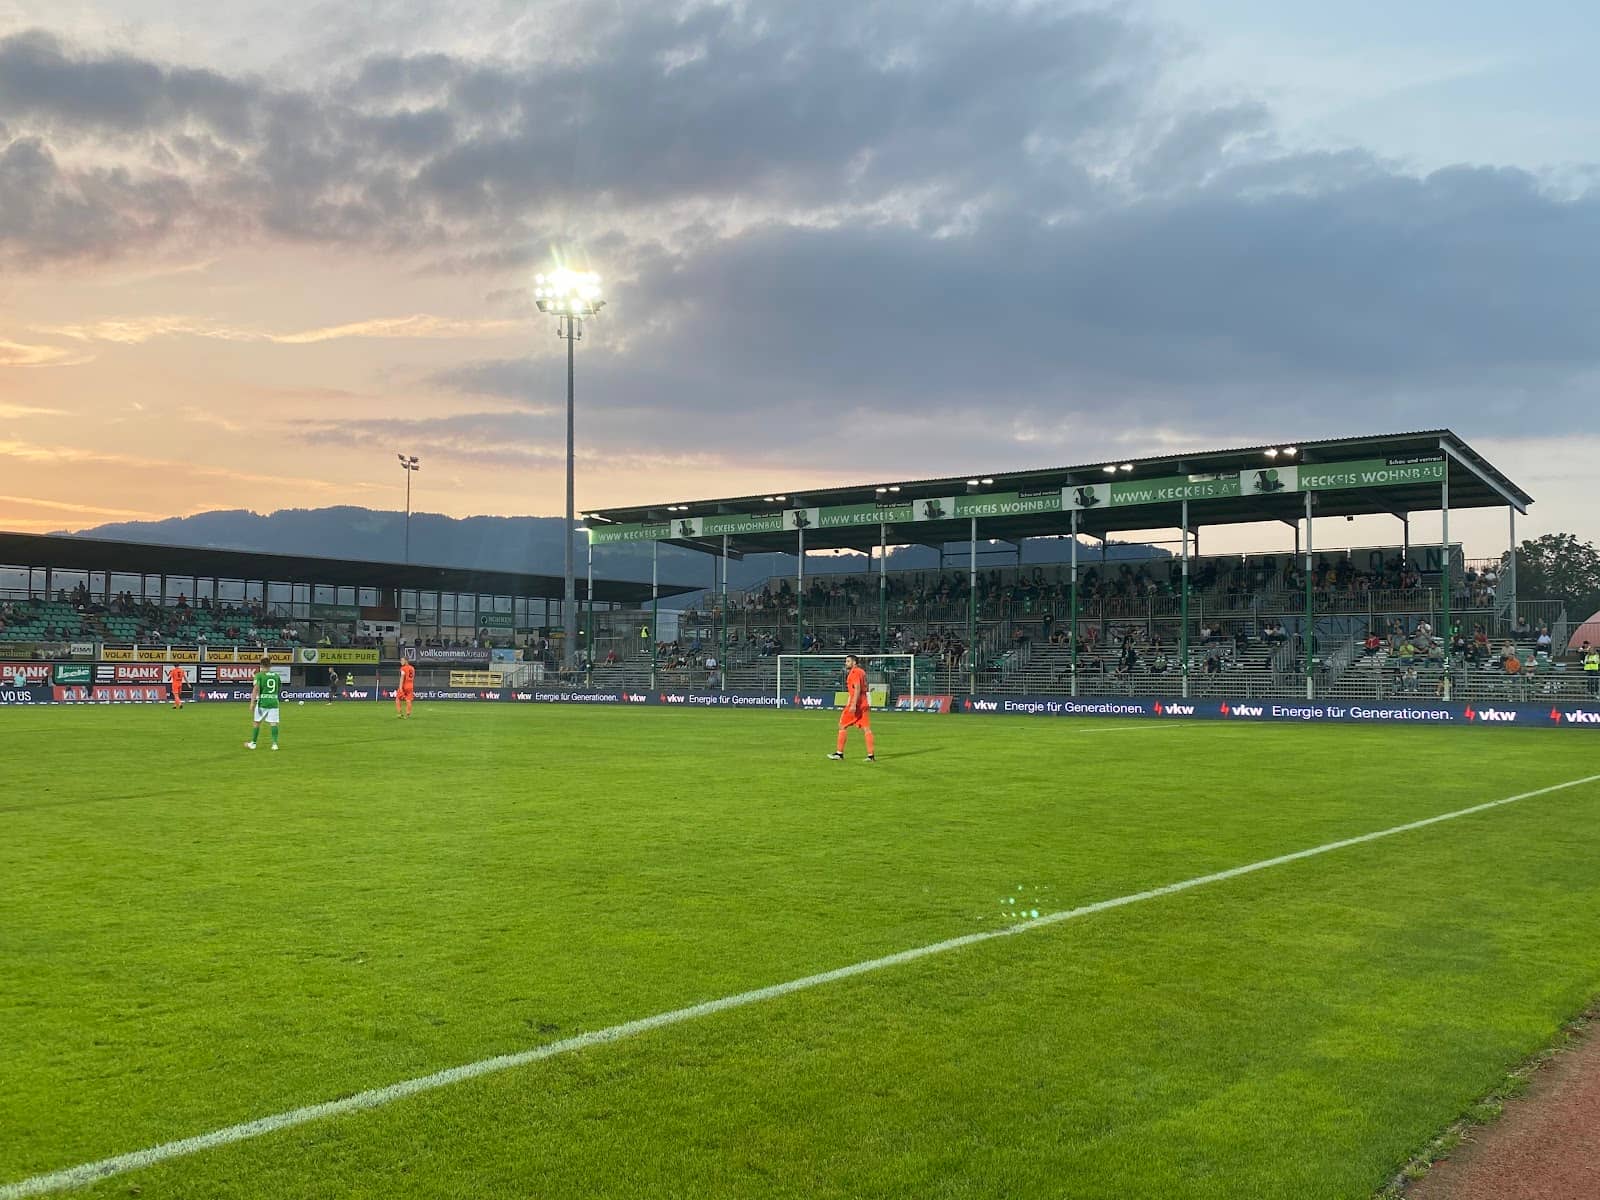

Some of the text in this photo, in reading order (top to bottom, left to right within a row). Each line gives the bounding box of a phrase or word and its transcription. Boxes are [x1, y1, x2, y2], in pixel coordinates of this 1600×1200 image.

[1301, 466, 1443, 487] KECKEIS WOHNBAU
[957, 499, 1060, 515] KECKEIS WOHNBAU
[737, 520, 782, 532] WOHNBAU
[320, 652, 352, 660] PLANET
[118, 667, 158, 678] BLANK
[220, 668, 257, 678] BLANK
[266, 678, 276, 693] 9
[208, 690, 228, 699] vkw
[350, 690, 368, 698] vkw
[535, 692, 618, 702] Energie für Generationen.
[629, 693, 647, 702] vkw
[667, 694, 685, 703] vkw
[689, 694, 717, 705] Energie
[719, 694, 730, 704] für
[802, 695, 822, 706] vkw
[974, 699, 997, 710] vkw
[1004, 701, 1146, 714] Energie für Generationen.
[1165, 703, 1194, 715] vkw
[1232, 704, 1263, 716] vkw
[1272, 705, 1454, 720] Energie für Generationen.
[1479, 708, 1516, 721] vkw
[1565, 709, 1600, 723] vkw
